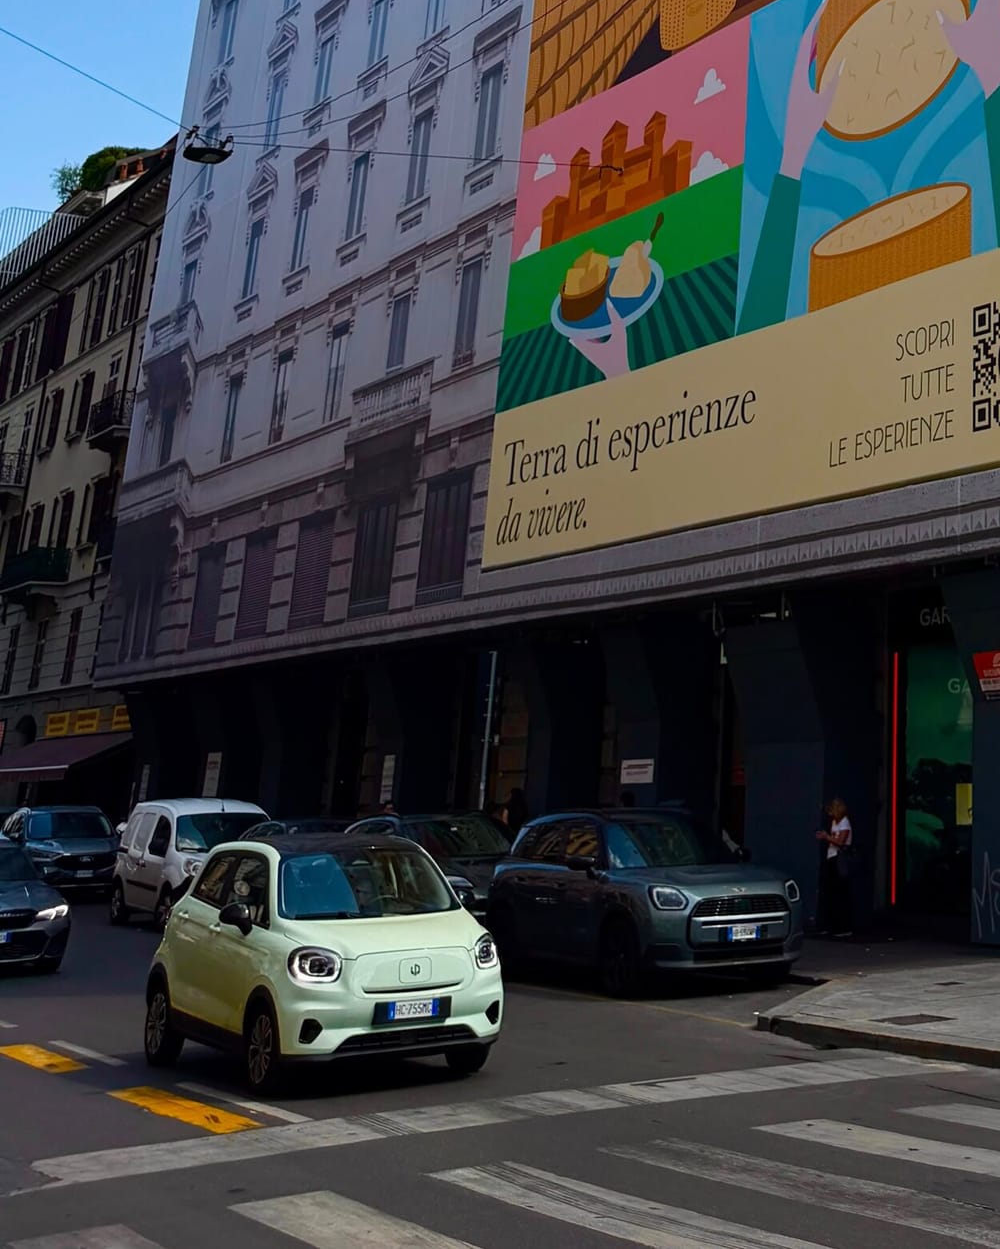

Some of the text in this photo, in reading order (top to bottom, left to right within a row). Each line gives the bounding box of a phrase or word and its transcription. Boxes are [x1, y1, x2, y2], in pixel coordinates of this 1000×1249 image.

[896, 319, 955, 362] SCOPRI
[901, 364, 955, 404] TUTTE
[505, 390, 757, 487] Terra di esperienze
[829, 410, 955, 468] LE ESPERIENZE
[497, 489, 588, 546] da vivere.
